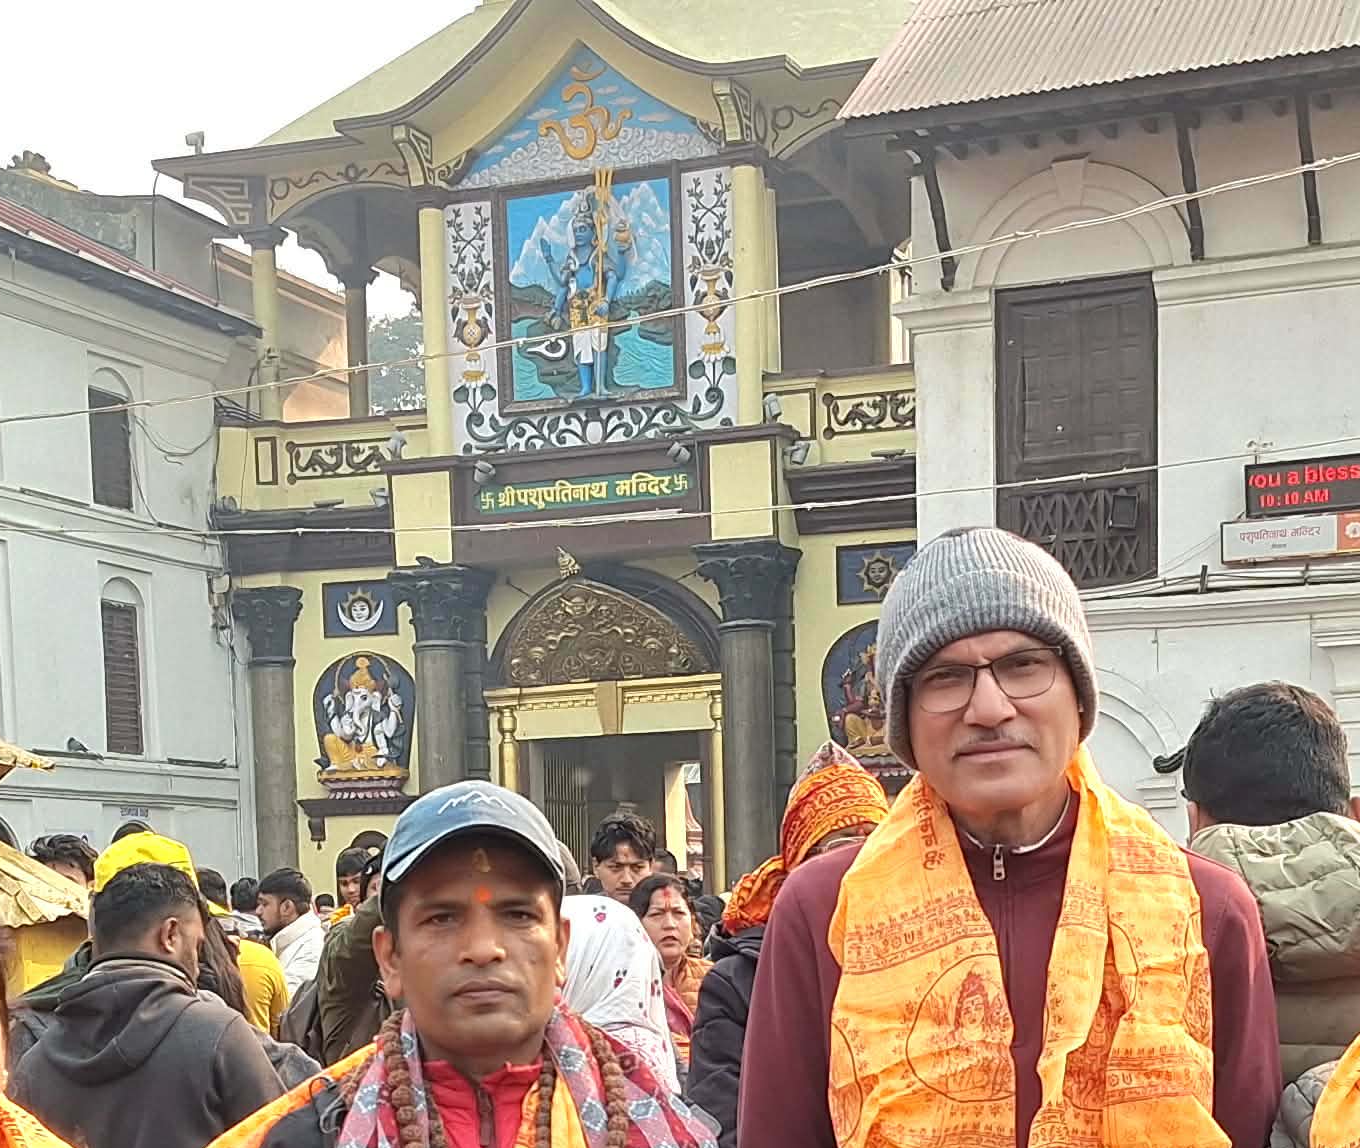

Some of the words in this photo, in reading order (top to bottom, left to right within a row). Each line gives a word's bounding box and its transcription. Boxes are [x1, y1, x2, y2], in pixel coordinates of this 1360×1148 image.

[615, 472, 673, 497] मन्दिर
[1288, 471, 1301, 485] a
[1304, 488, 1330, 504] AM
